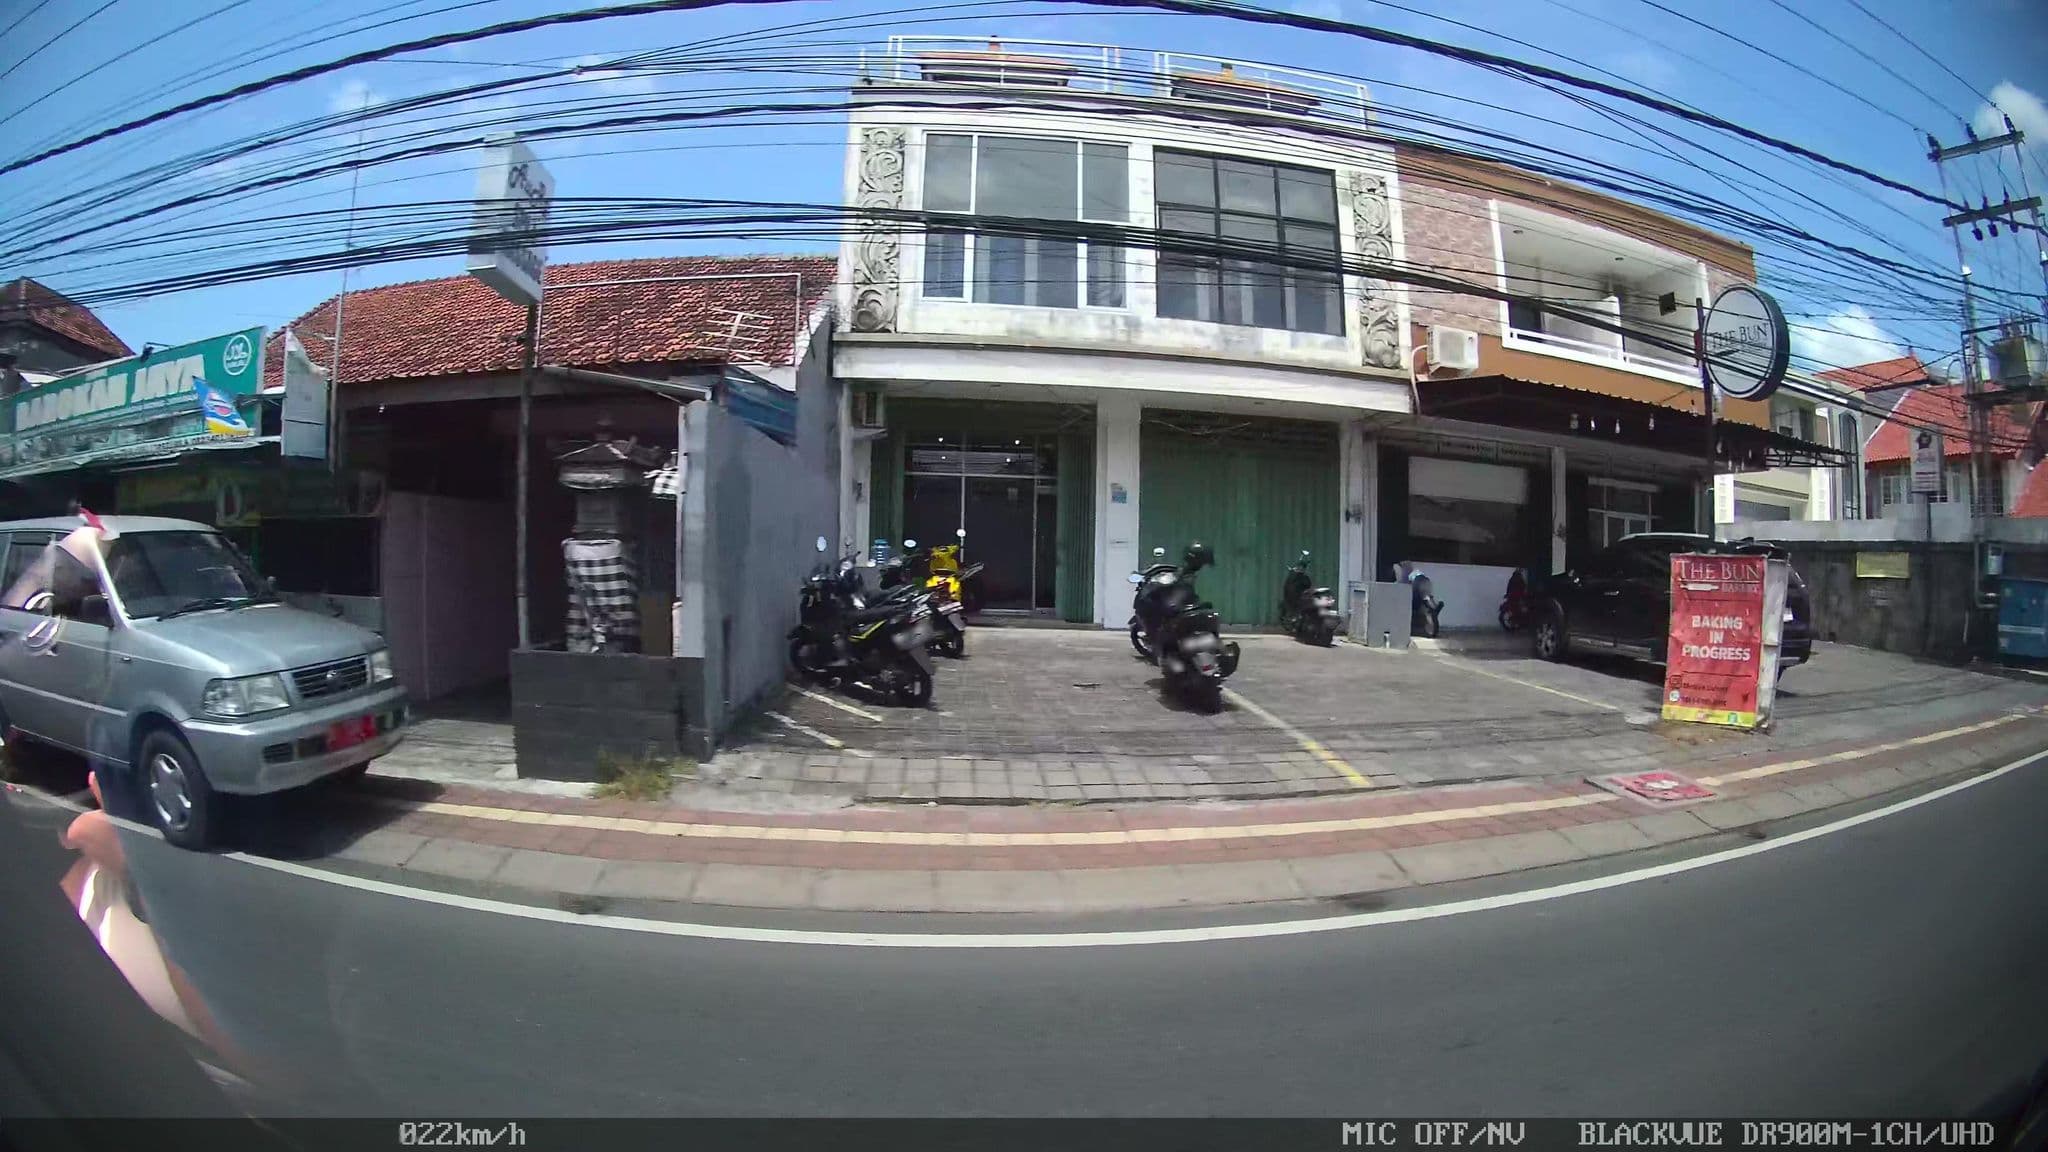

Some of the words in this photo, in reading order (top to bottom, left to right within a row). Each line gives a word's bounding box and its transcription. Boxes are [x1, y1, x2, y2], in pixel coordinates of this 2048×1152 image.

[1738, 322, 1769, 344] BUN
[1676, 559, 1716, 579] THE
[1721, 562, 1760, 580] BUN
[1691, 615, 1743, 630] BAKING
[1709, 630, 1724, 644] IN
[1681, 643, 1751, 661] PROGRESS
